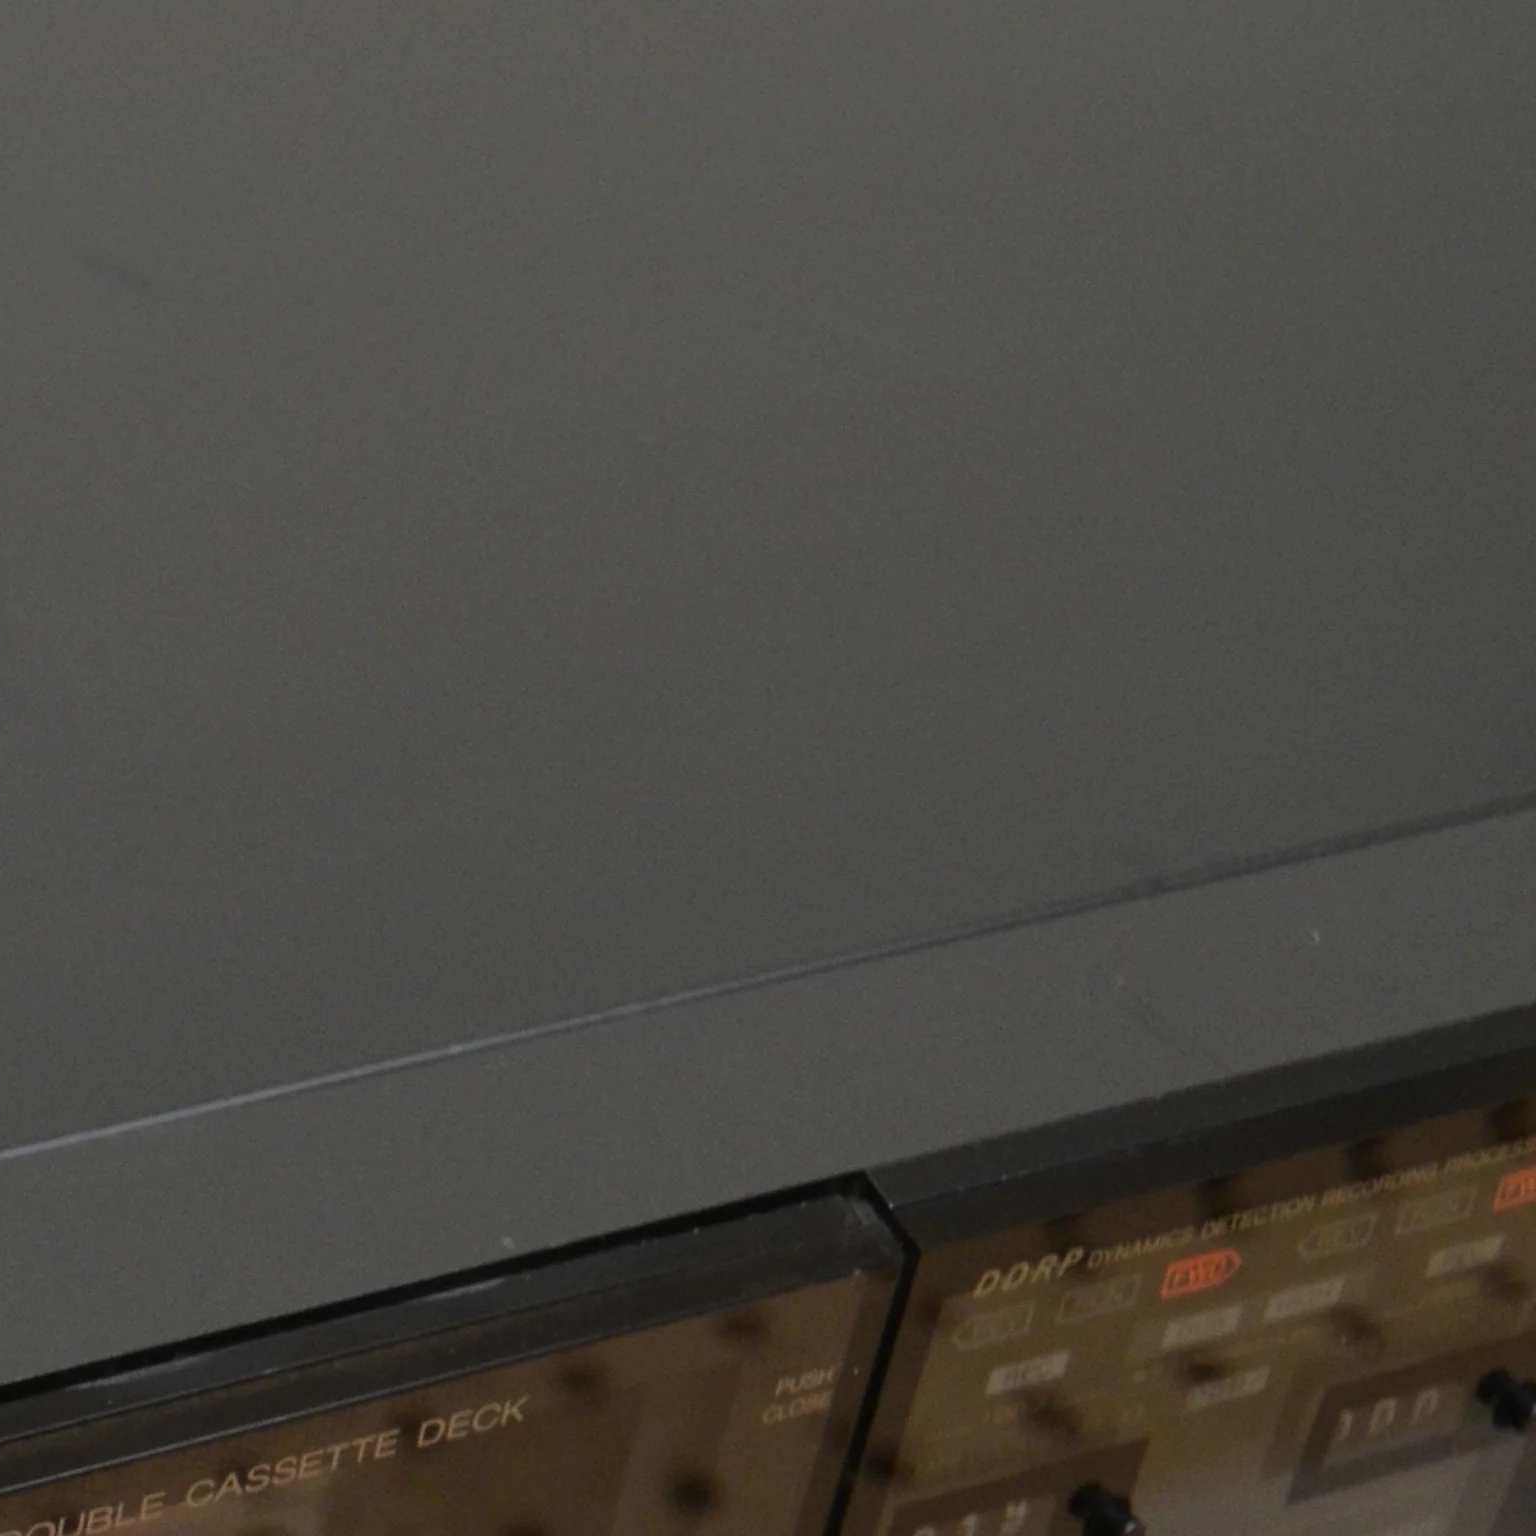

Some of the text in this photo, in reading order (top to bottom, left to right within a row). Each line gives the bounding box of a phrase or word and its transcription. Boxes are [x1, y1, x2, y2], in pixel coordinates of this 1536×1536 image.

[973, 1246, 1085, 1299] DDRP
[185, 1428, 402, 1508] CASSETTE
[416, 1395, 529, 1450] DECK
